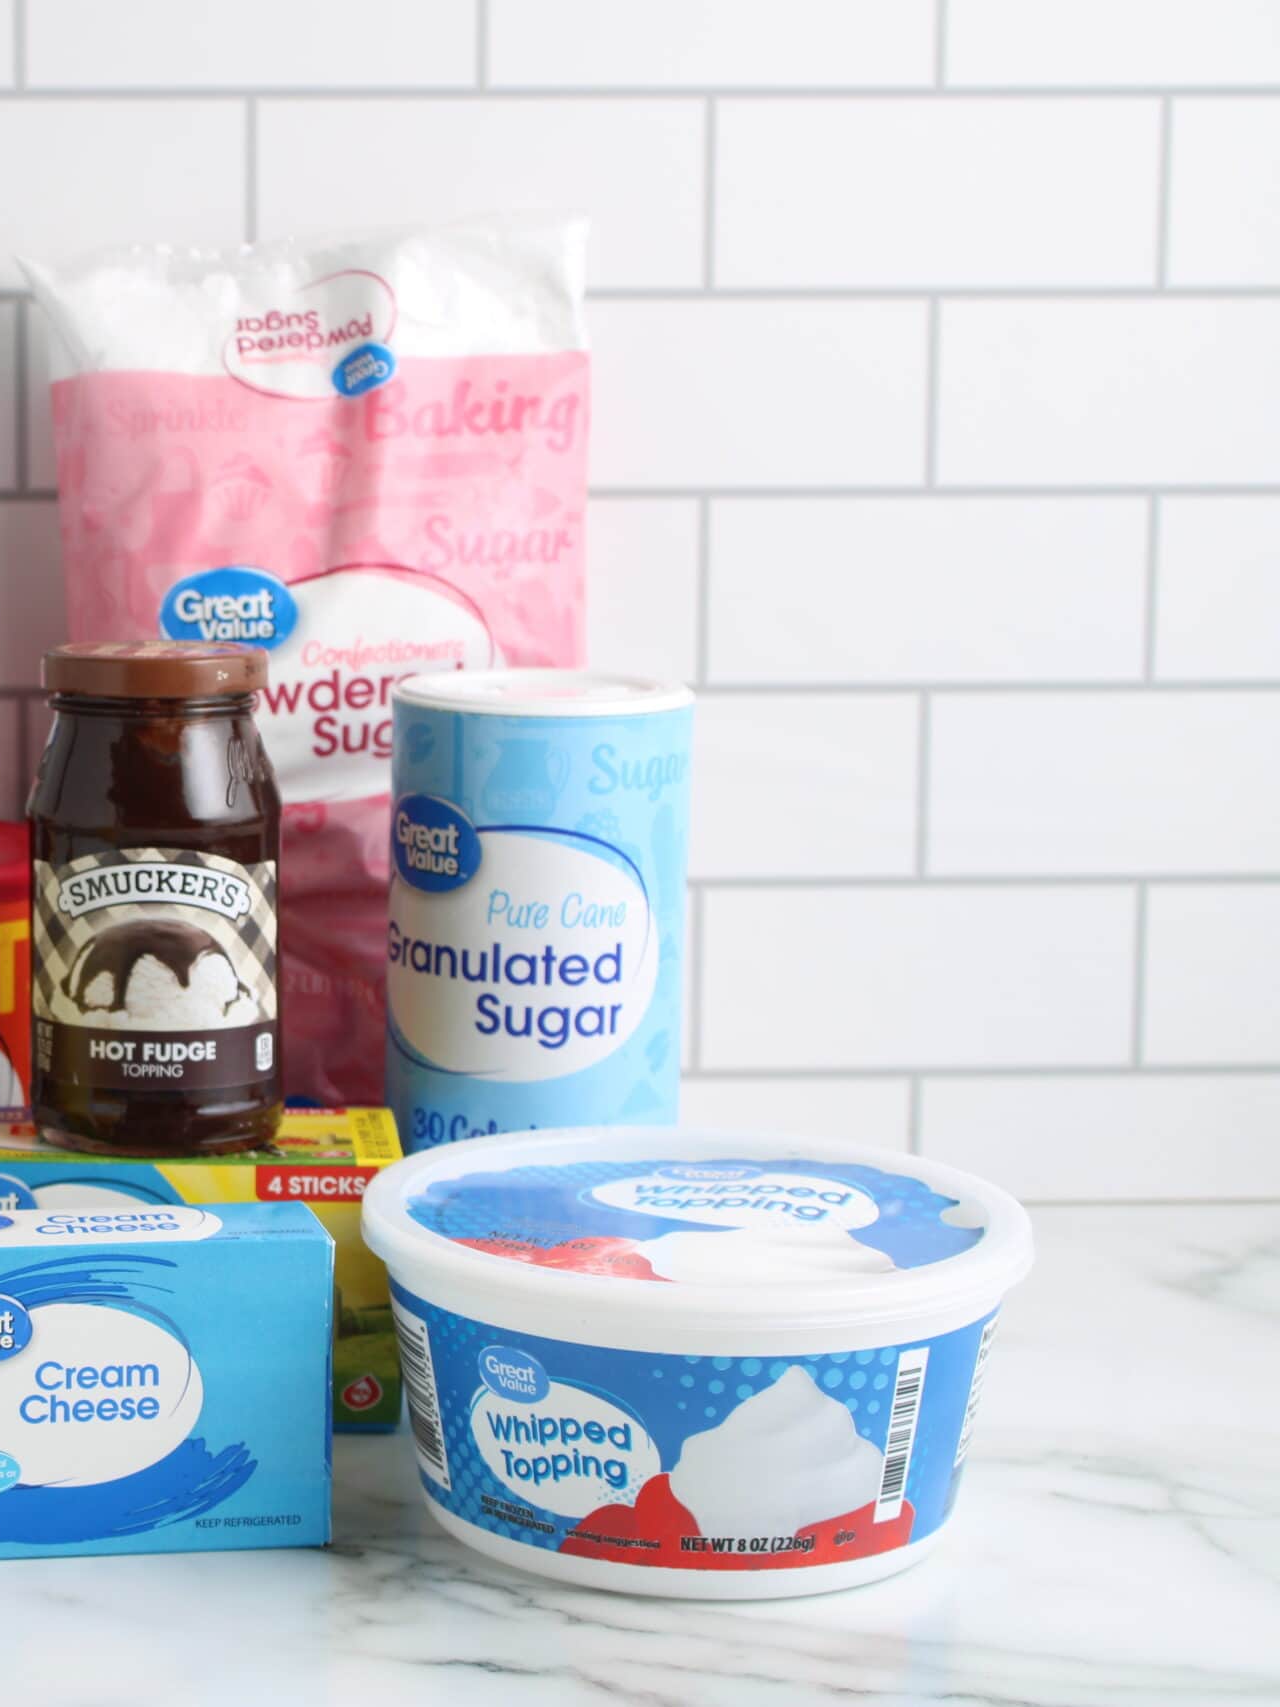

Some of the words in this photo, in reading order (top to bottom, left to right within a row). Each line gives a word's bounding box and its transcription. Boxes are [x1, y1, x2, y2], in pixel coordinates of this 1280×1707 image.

[235, 310, 319, 333] Sugar
[236, 312, 374, 354] Powdered
[365, 381, 581, 451] Baking
[421, 516, 573, 579] Sugar
[174, 589, 274, 620] Great
[200, 618, 275, 641] Value
[312, 715, 392, 759] Sug
[396, 812, 461, 855] Great
[406, 847, 458, 876] Value
[70, 869, 240, 908] SMUCKER'S
[488, 889, 549, 929] Pure
[560, 892, 627, 929] Cane
[389, 920, 622, 986] Granulated
[475, 993, 622, 1049] Sugar
[89, 1040, 137, 1061] HOT
[143, 1041, 217, 1062] FUDGE
[122, 1063, 184, 1078] TOPPING
[413, 1107, 445, 1141] 30
[268, 1176, 283, 1195] 4
[288, 1176, 367, 1196] STICKS
[634, 1183, 853, 1207] Whipped
[46, 1212, 175, 1224] Cream
[634, 1195, 828, 1221] Topping
[34, 1221, 181, 1236] Cheese
[35, 1361, 160, 1391] Cream
[485, 1355, 536, 1385] Great
[499, 1375, 537, 1395] Value
[19, 1395, 160, 1425] Cheese
[486, 1411, 632, 1452] Whipped
[501, 1448, 629, 1490] Topping
[195, 1518, 221, 1529] KEEP
[223, 1515, 302, 1528] REFRIGERATED
[502, 1500, 534, 1519] FROZEN
[565, 1528, 602, 1543] serving
[680, 1536, 711, 1551] NET
[712, 1537, 735, 1552] WT
[736, 1538, 746, 1553] 8
[749, 1538, 768, 1553] OZ
[770, 1534, 816, 1554] (226g)
